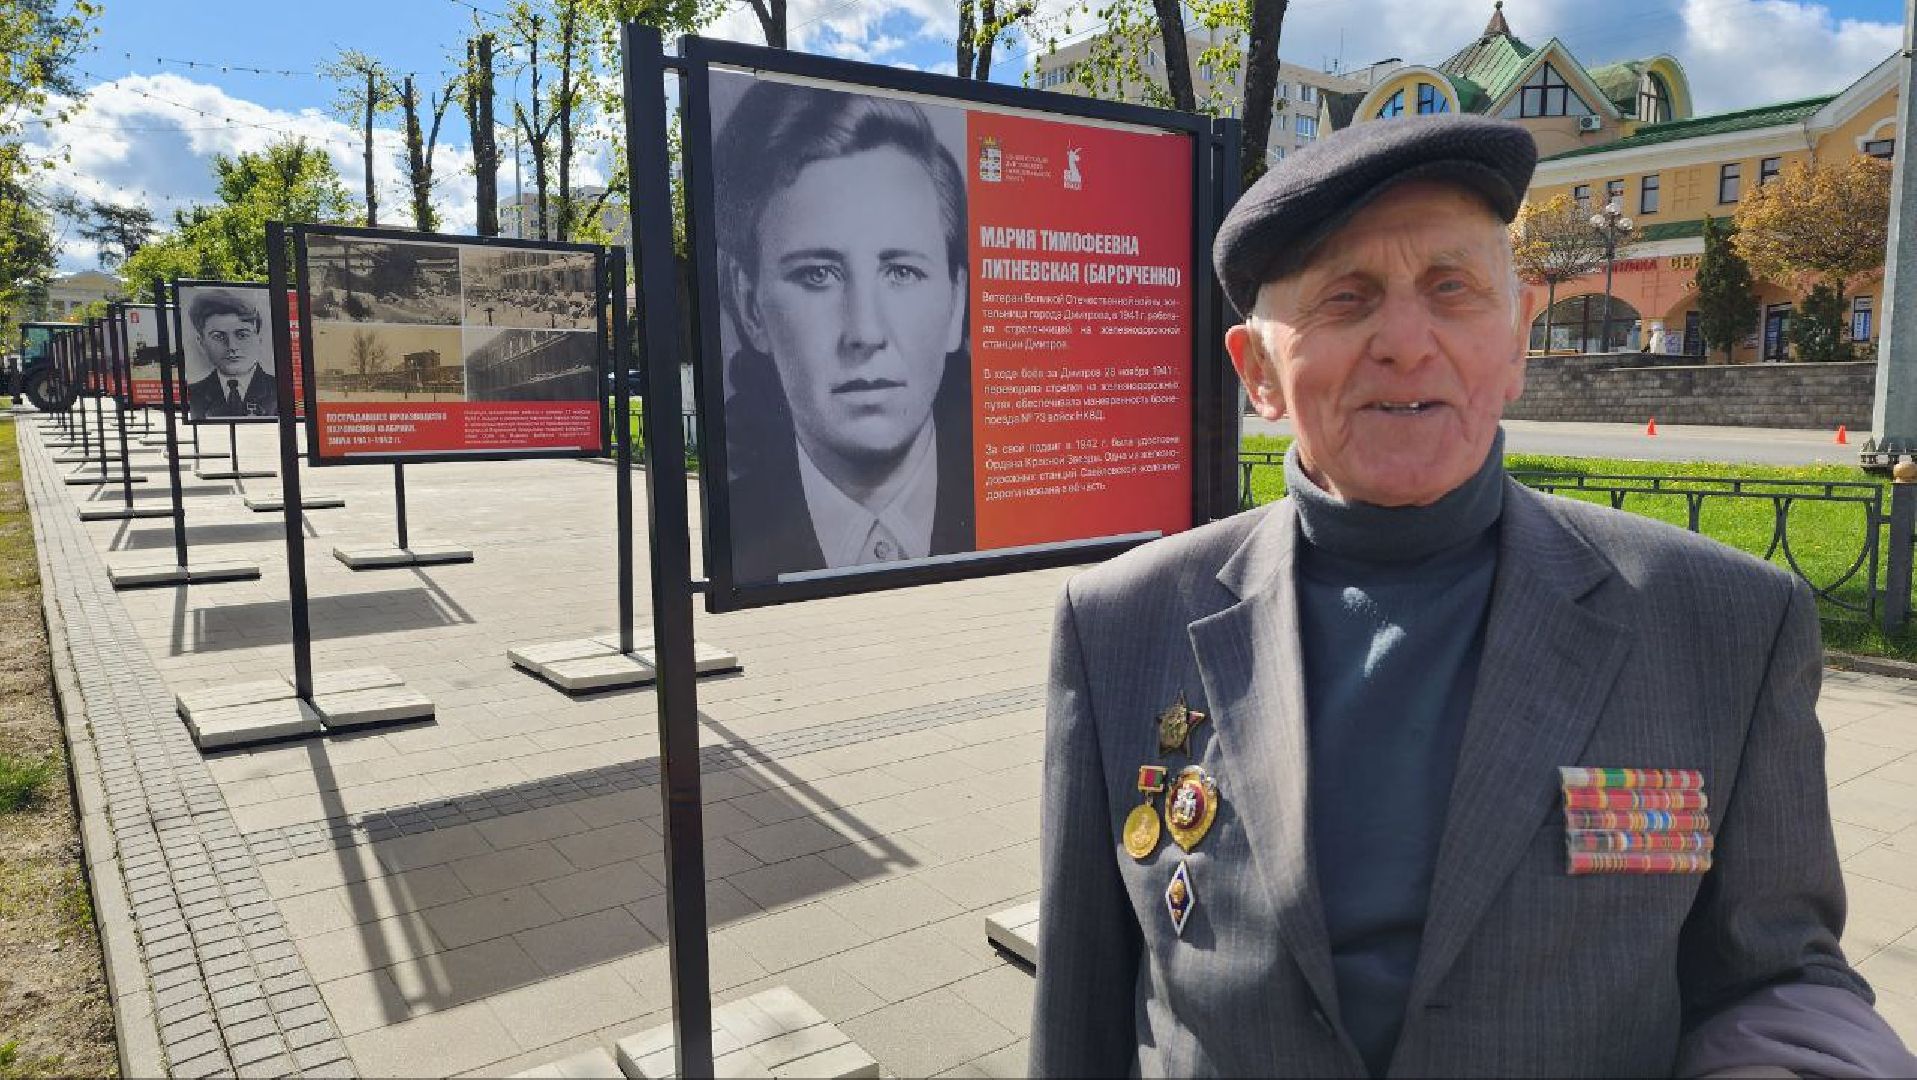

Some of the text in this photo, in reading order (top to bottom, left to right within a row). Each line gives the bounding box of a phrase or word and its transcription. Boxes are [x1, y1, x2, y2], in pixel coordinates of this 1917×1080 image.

[980, 226, 1139, 256] МАРИЯ ТИМОФЕЕВНА
[1084, 263, 1181, 288] (БАРСУЧЕНКО)
[982, 292, 1023, 305] Ветеран
[983, 368, 991, 379] В
